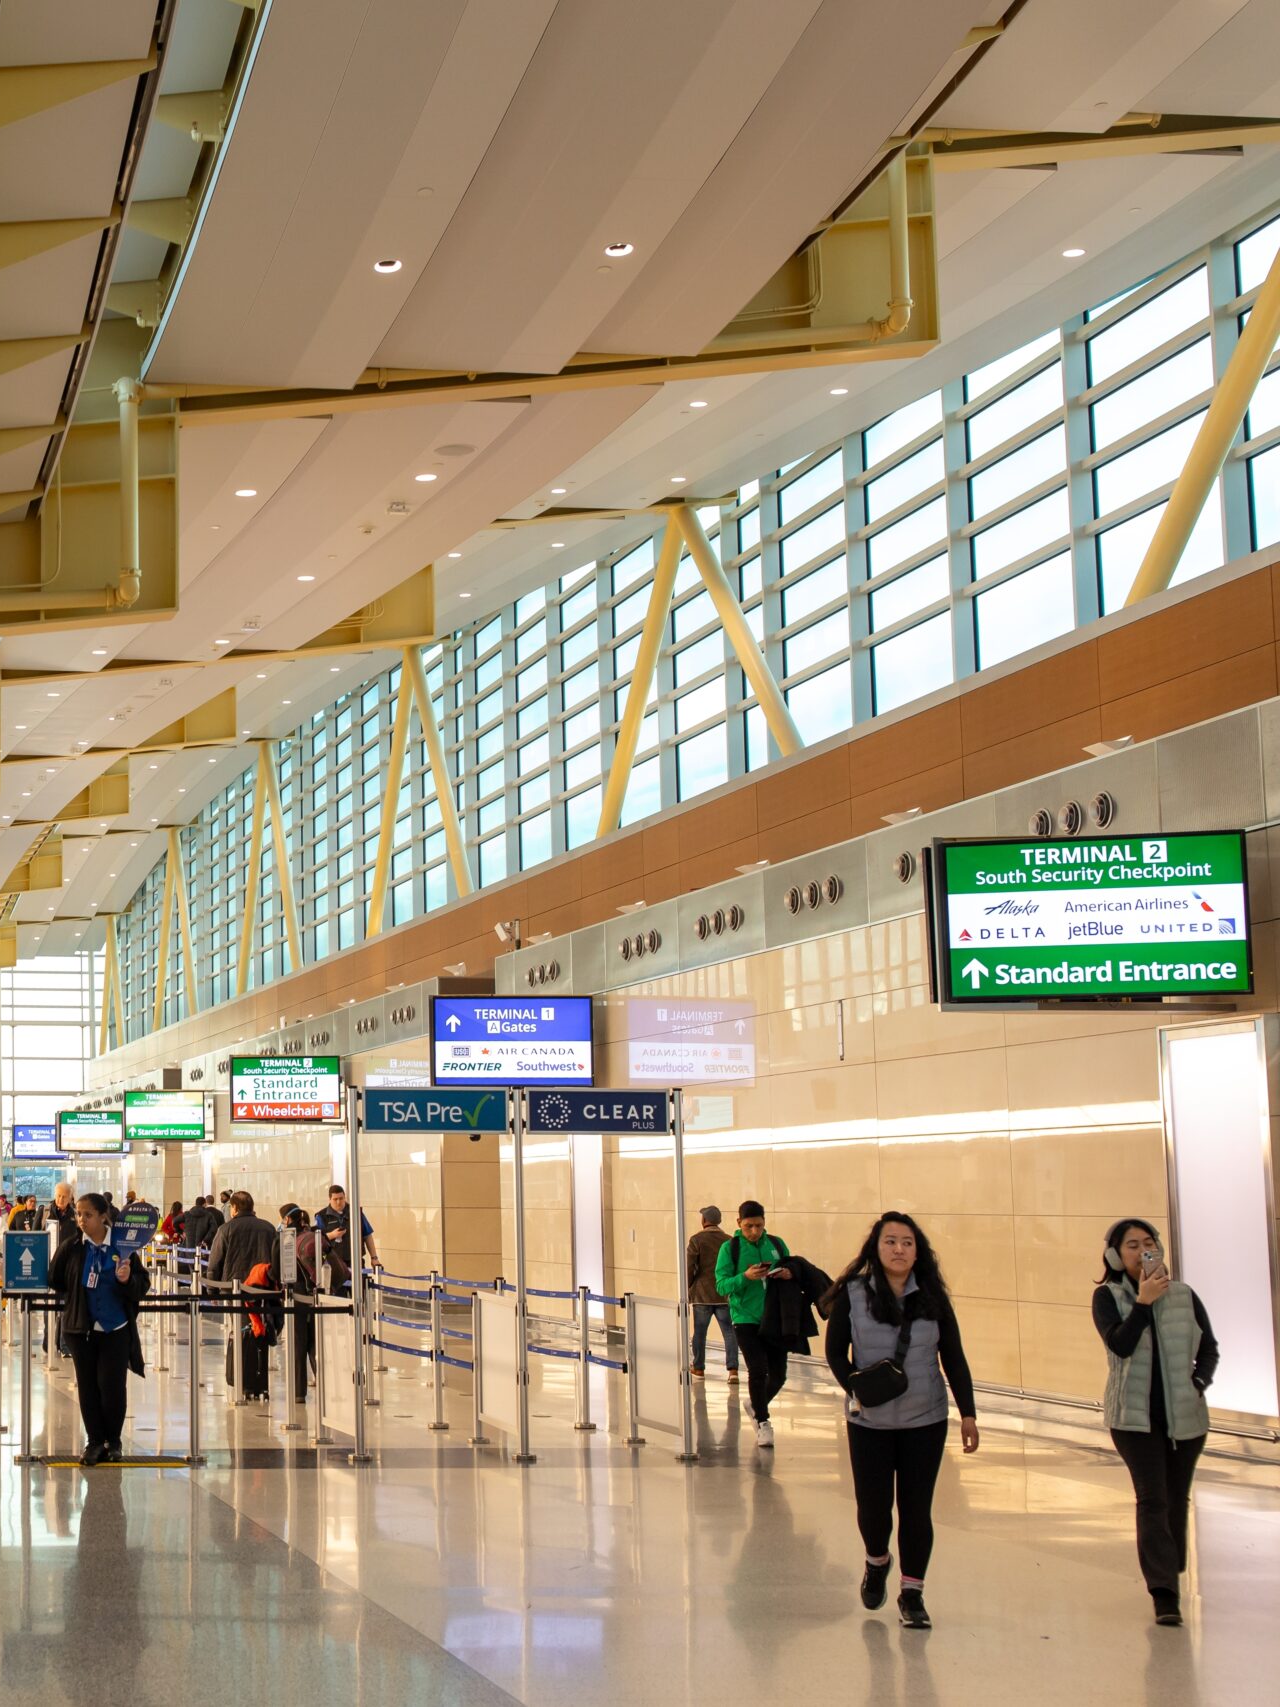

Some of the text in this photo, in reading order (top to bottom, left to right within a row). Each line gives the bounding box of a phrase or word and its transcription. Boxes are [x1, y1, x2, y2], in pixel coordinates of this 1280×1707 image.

[1020, 842, 1162, 866] TERMINAL 2
[975, 862, 1212, 886] South Security Checkpoint
[983, 899, 1040, 917] Alaska
[1064, 897, 1189, 913] American Airlines
[980, 926, 1046, 940] DELTA
[1067, 921, 1124, 940] jetBlue
[1140, 922, 1214, 934] UNITED
[995, 960, 1237, 985] Standard Entrance
[474, 1008, 538, 1020] TERMINAL
[501, 1021, 537, 1033] Gates
[497, 1048, 575, 1056] AIR CANADA
[260, 1059, 302, 1068] TERMINAL
[442, 1062, 502, 1072] FRONTIER
[516, 1061, 577, 1072] Southwest
[243, 1066, 328, 1076] South Security Checkpoint
[253, 1076, 318, 1089] Standard
[254, 1090, 318, 1100] Entrance
[253, 1104, 320, 1117] Wheelchair
[378, 1101, 463, 1123] TSA Pre
[583, 1104, 654, 1120] CLEAR
[632, 1121, 655, 1130] PLUS
[138, 1128, 200, 1136] Standard Entrance
